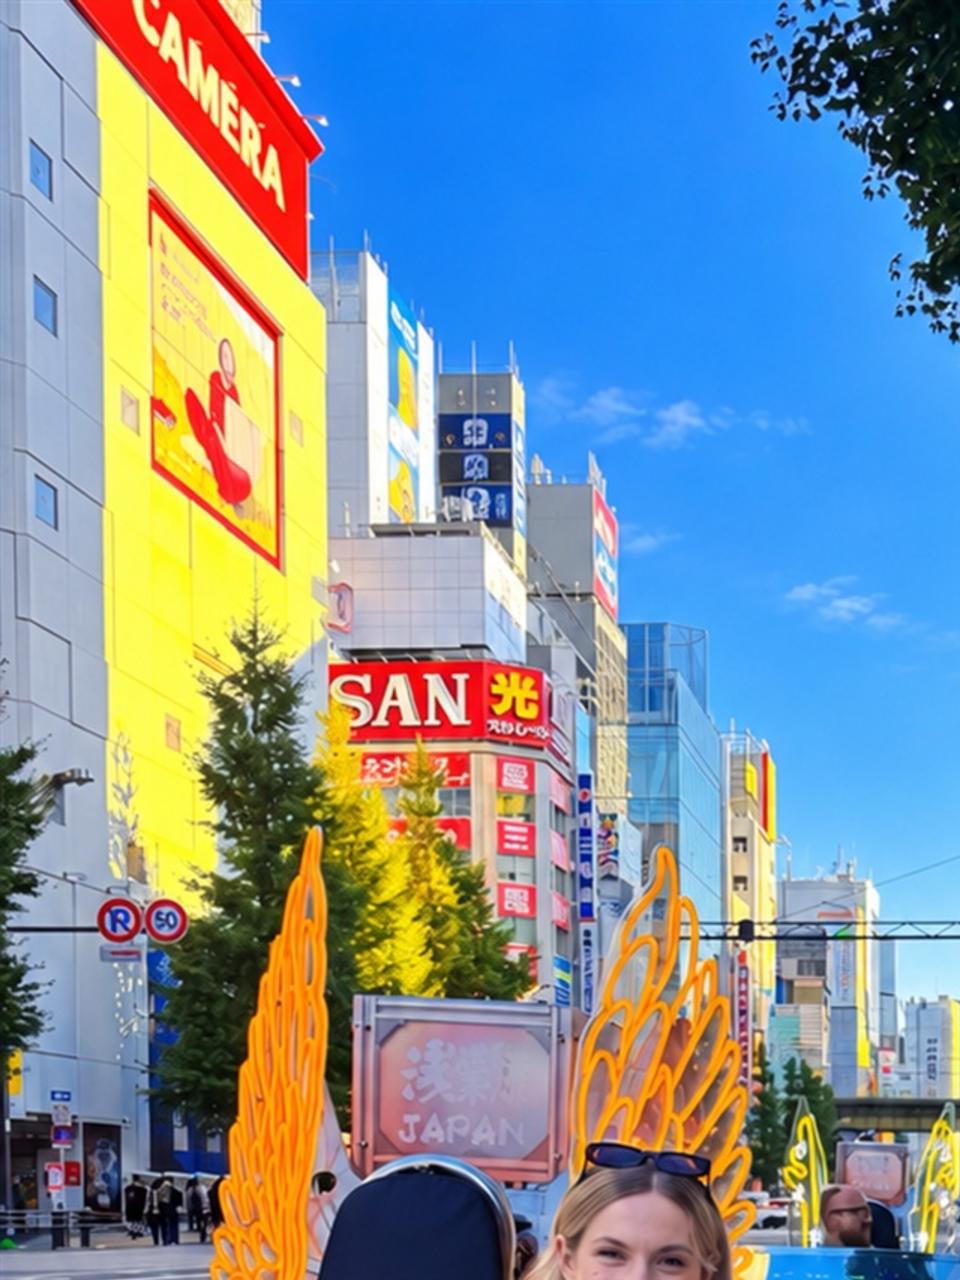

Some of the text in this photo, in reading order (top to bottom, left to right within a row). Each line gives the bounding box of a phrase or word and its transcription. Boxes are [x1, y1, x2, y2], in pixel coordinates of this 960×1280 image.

[132, 0, 286, 213] CAMERA
[329, 673, 472, 728] SAN
[491, 671, 540, 720] 光
[398, 1112, 525, 1146] JAPAN
